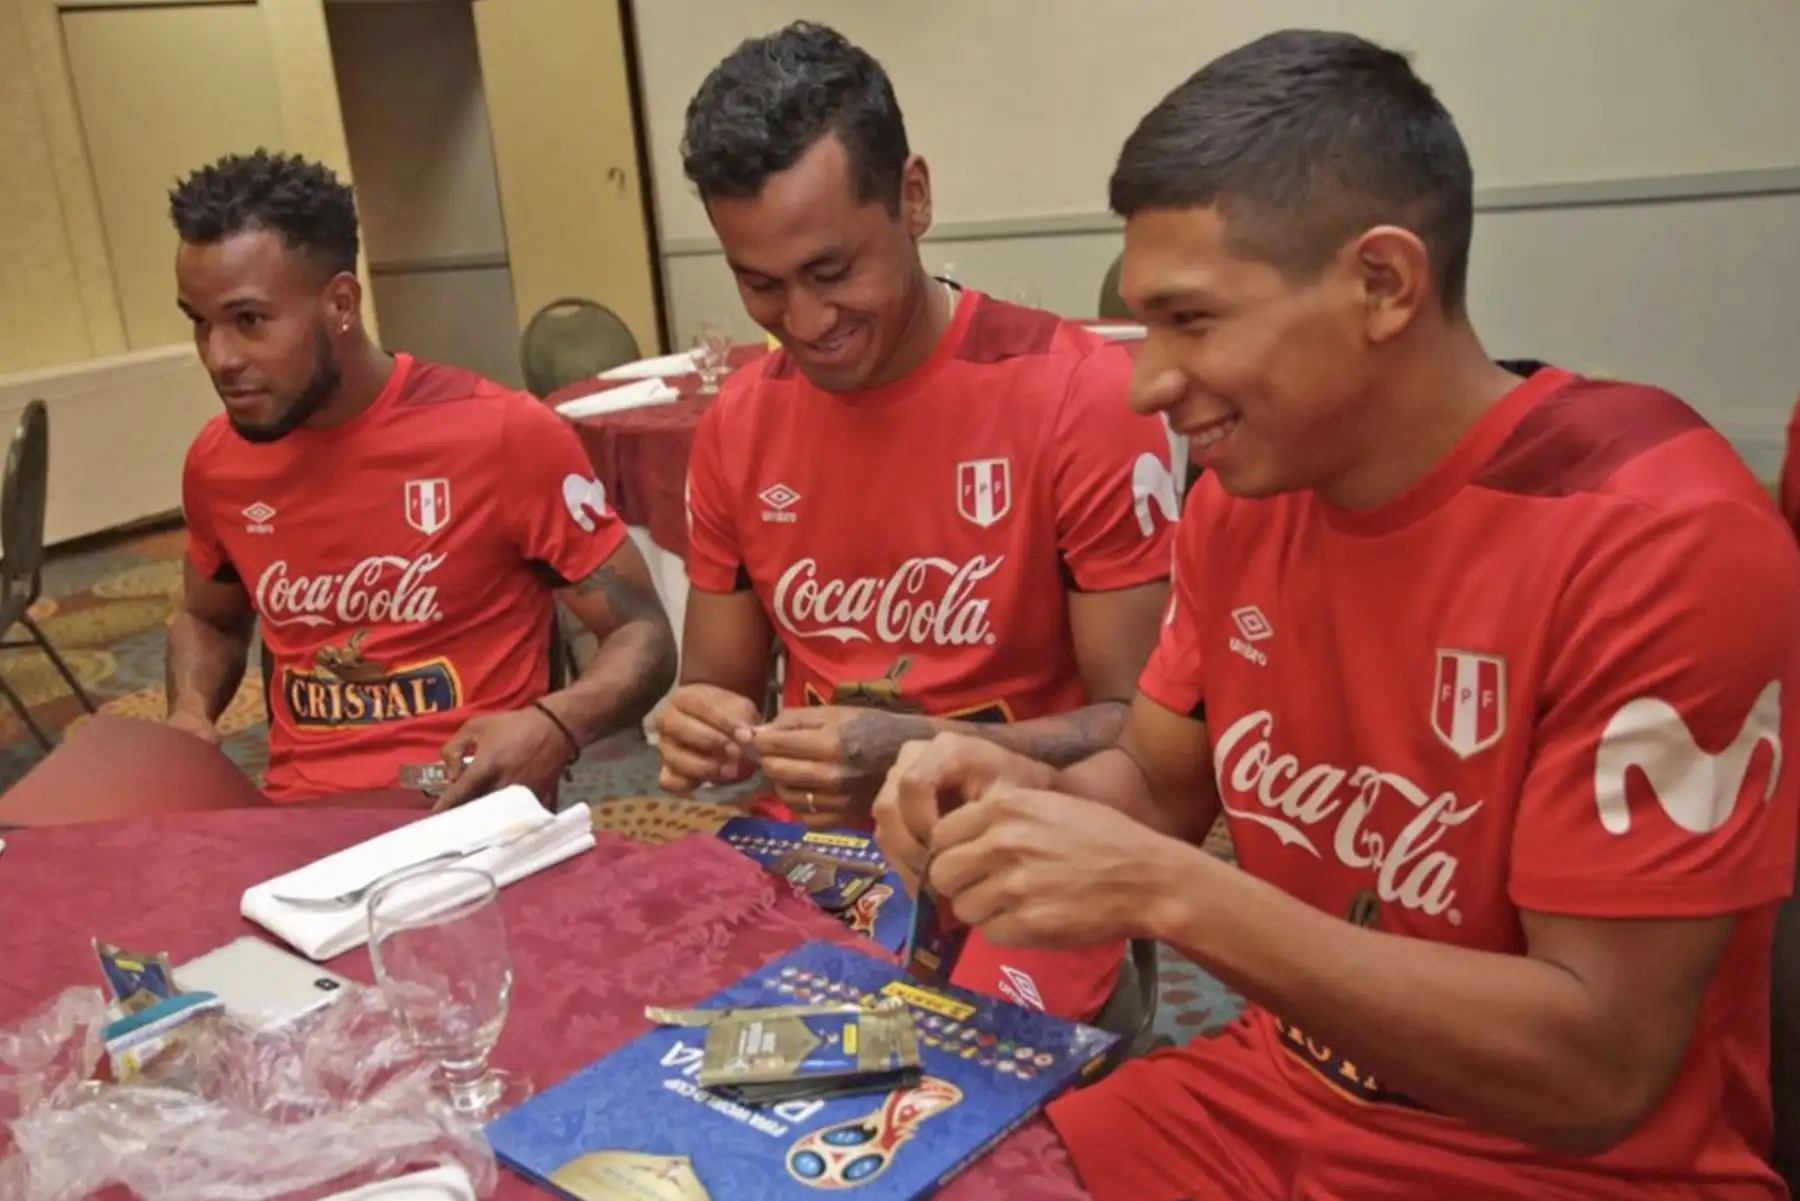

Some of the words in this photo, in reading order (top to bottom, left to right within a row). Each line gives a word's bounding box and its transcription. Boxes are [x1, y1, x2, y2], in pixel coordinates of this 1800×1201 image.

[256, 552, 447, 627] Coca-Cola
[774, 555, 1005, 646] Coca-Cola
[291, 680, 439, 722] CRISTAL
